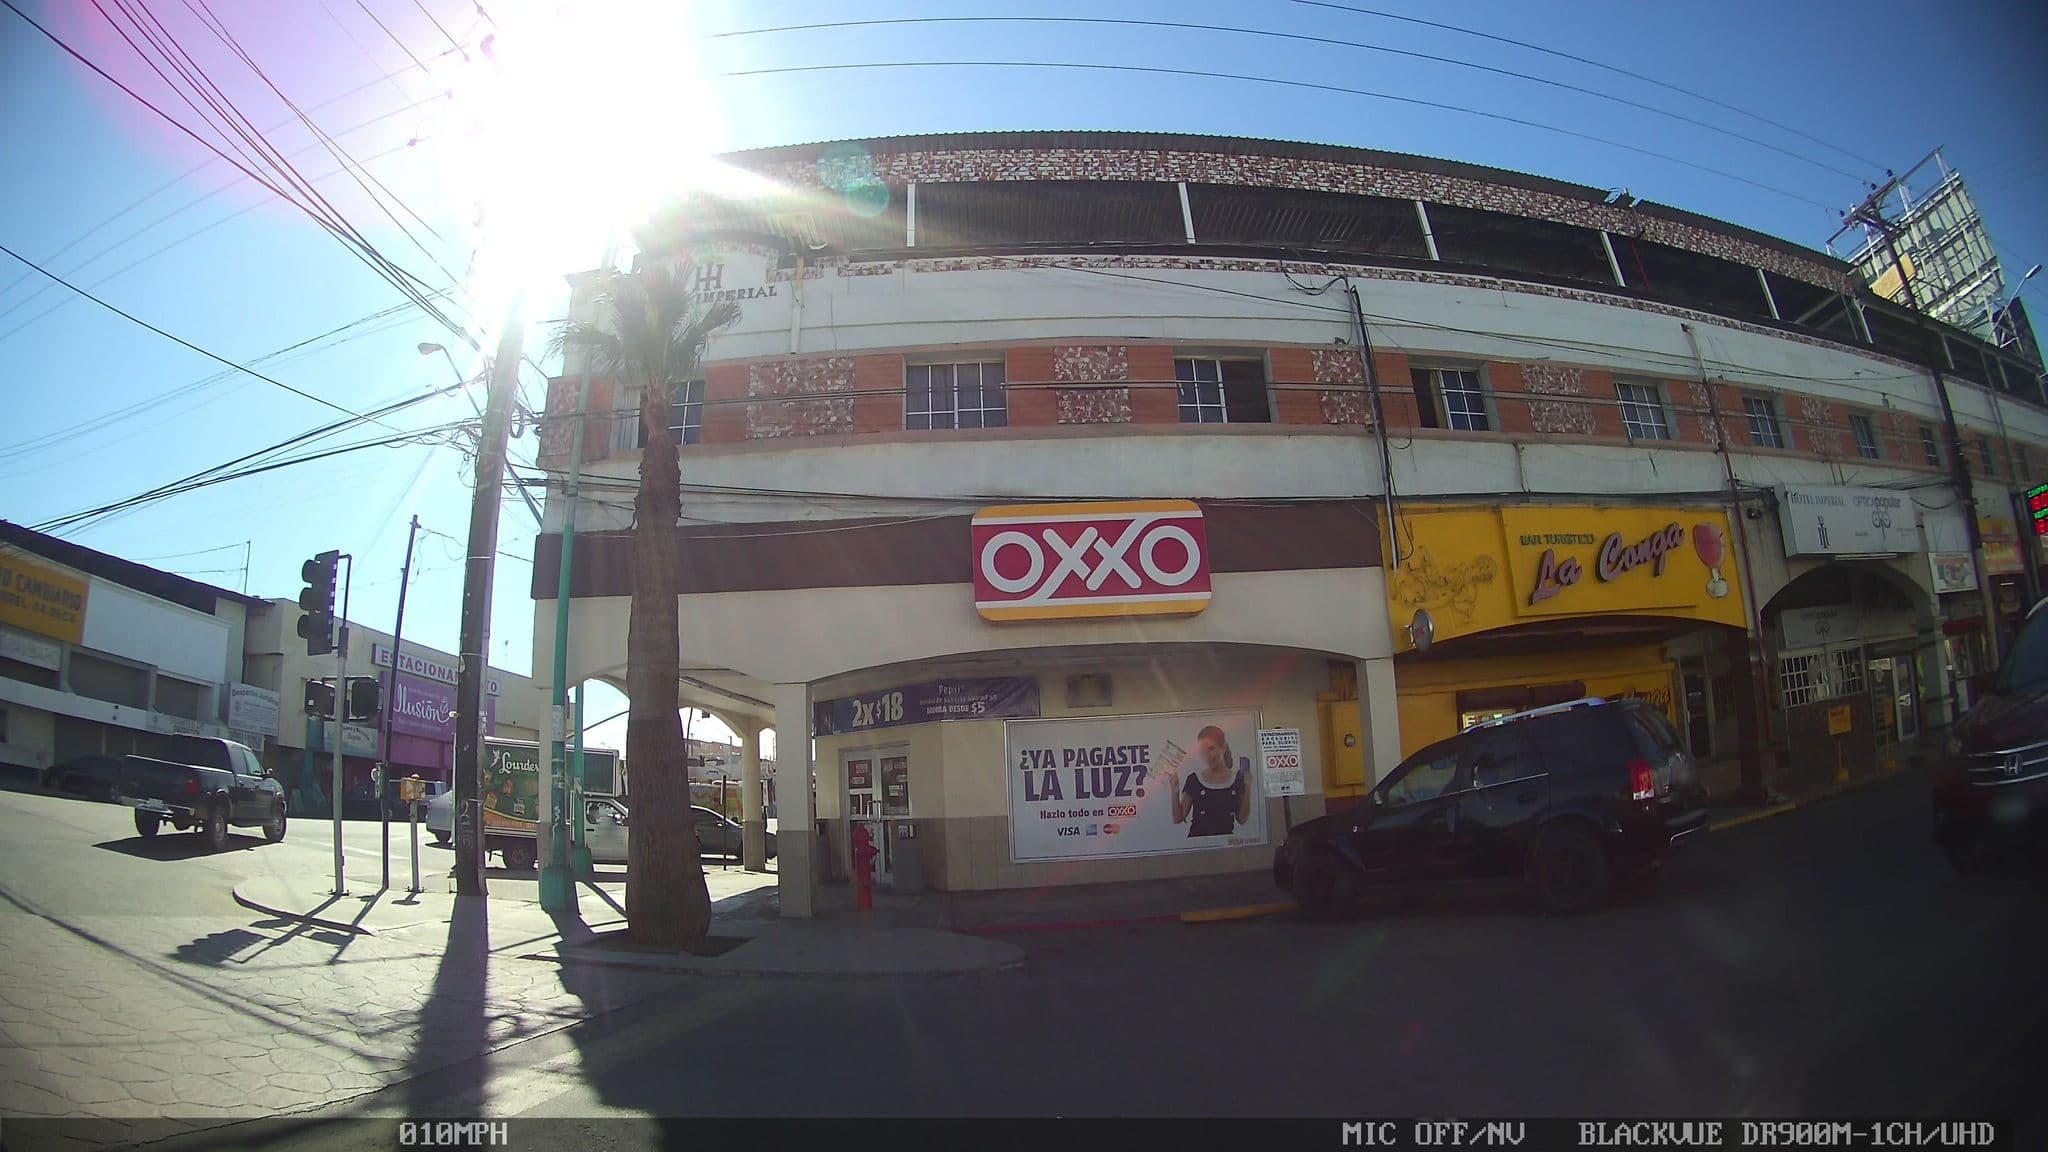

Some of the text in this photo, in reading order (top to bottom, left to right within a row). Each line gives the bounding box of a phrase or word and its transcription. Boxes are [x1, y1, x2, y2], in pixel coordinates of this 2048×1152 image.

[695, 286, 777, 303] IMPERIAL
[1520, 535, 1541, 546] BAR
[981, 525, 1201, 601] OXXO
[1528, 521, 1686, 607] La Conga
[970, 701, 986, 716] $5
[1019, 744, 1149, 770] ¿YA PAGASTE
[1266, 754, 1299, 769] OXXO
[1024, 765, 1147, 801] LA LUZ?
[1040, 806, 1136, 819] Hazlo todo en OXXO
[1057, 827, 1080, 836] VISA
